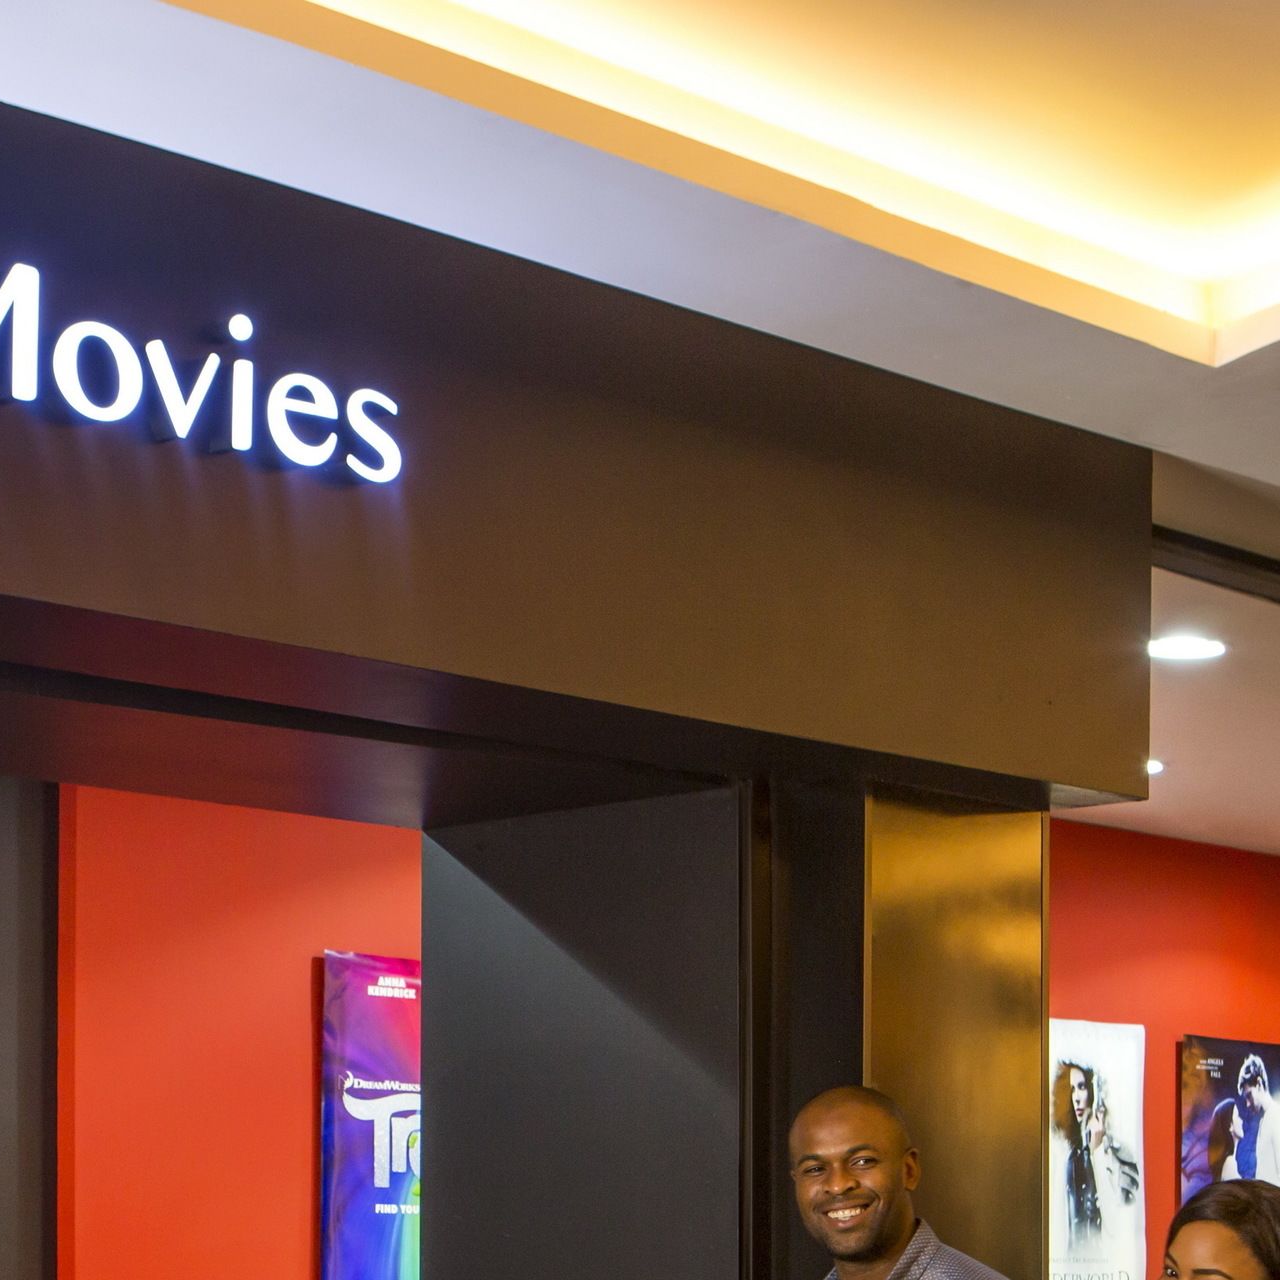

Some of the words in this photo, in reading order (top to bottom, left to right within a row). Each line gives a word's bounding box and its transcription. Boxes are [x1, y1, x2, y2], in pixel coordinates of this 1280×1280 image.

[377, 975, 406, 988] ANNA
[367, 984, 417, 1000] KENDRICK
[375, 1203, 399, 1214] FIND
